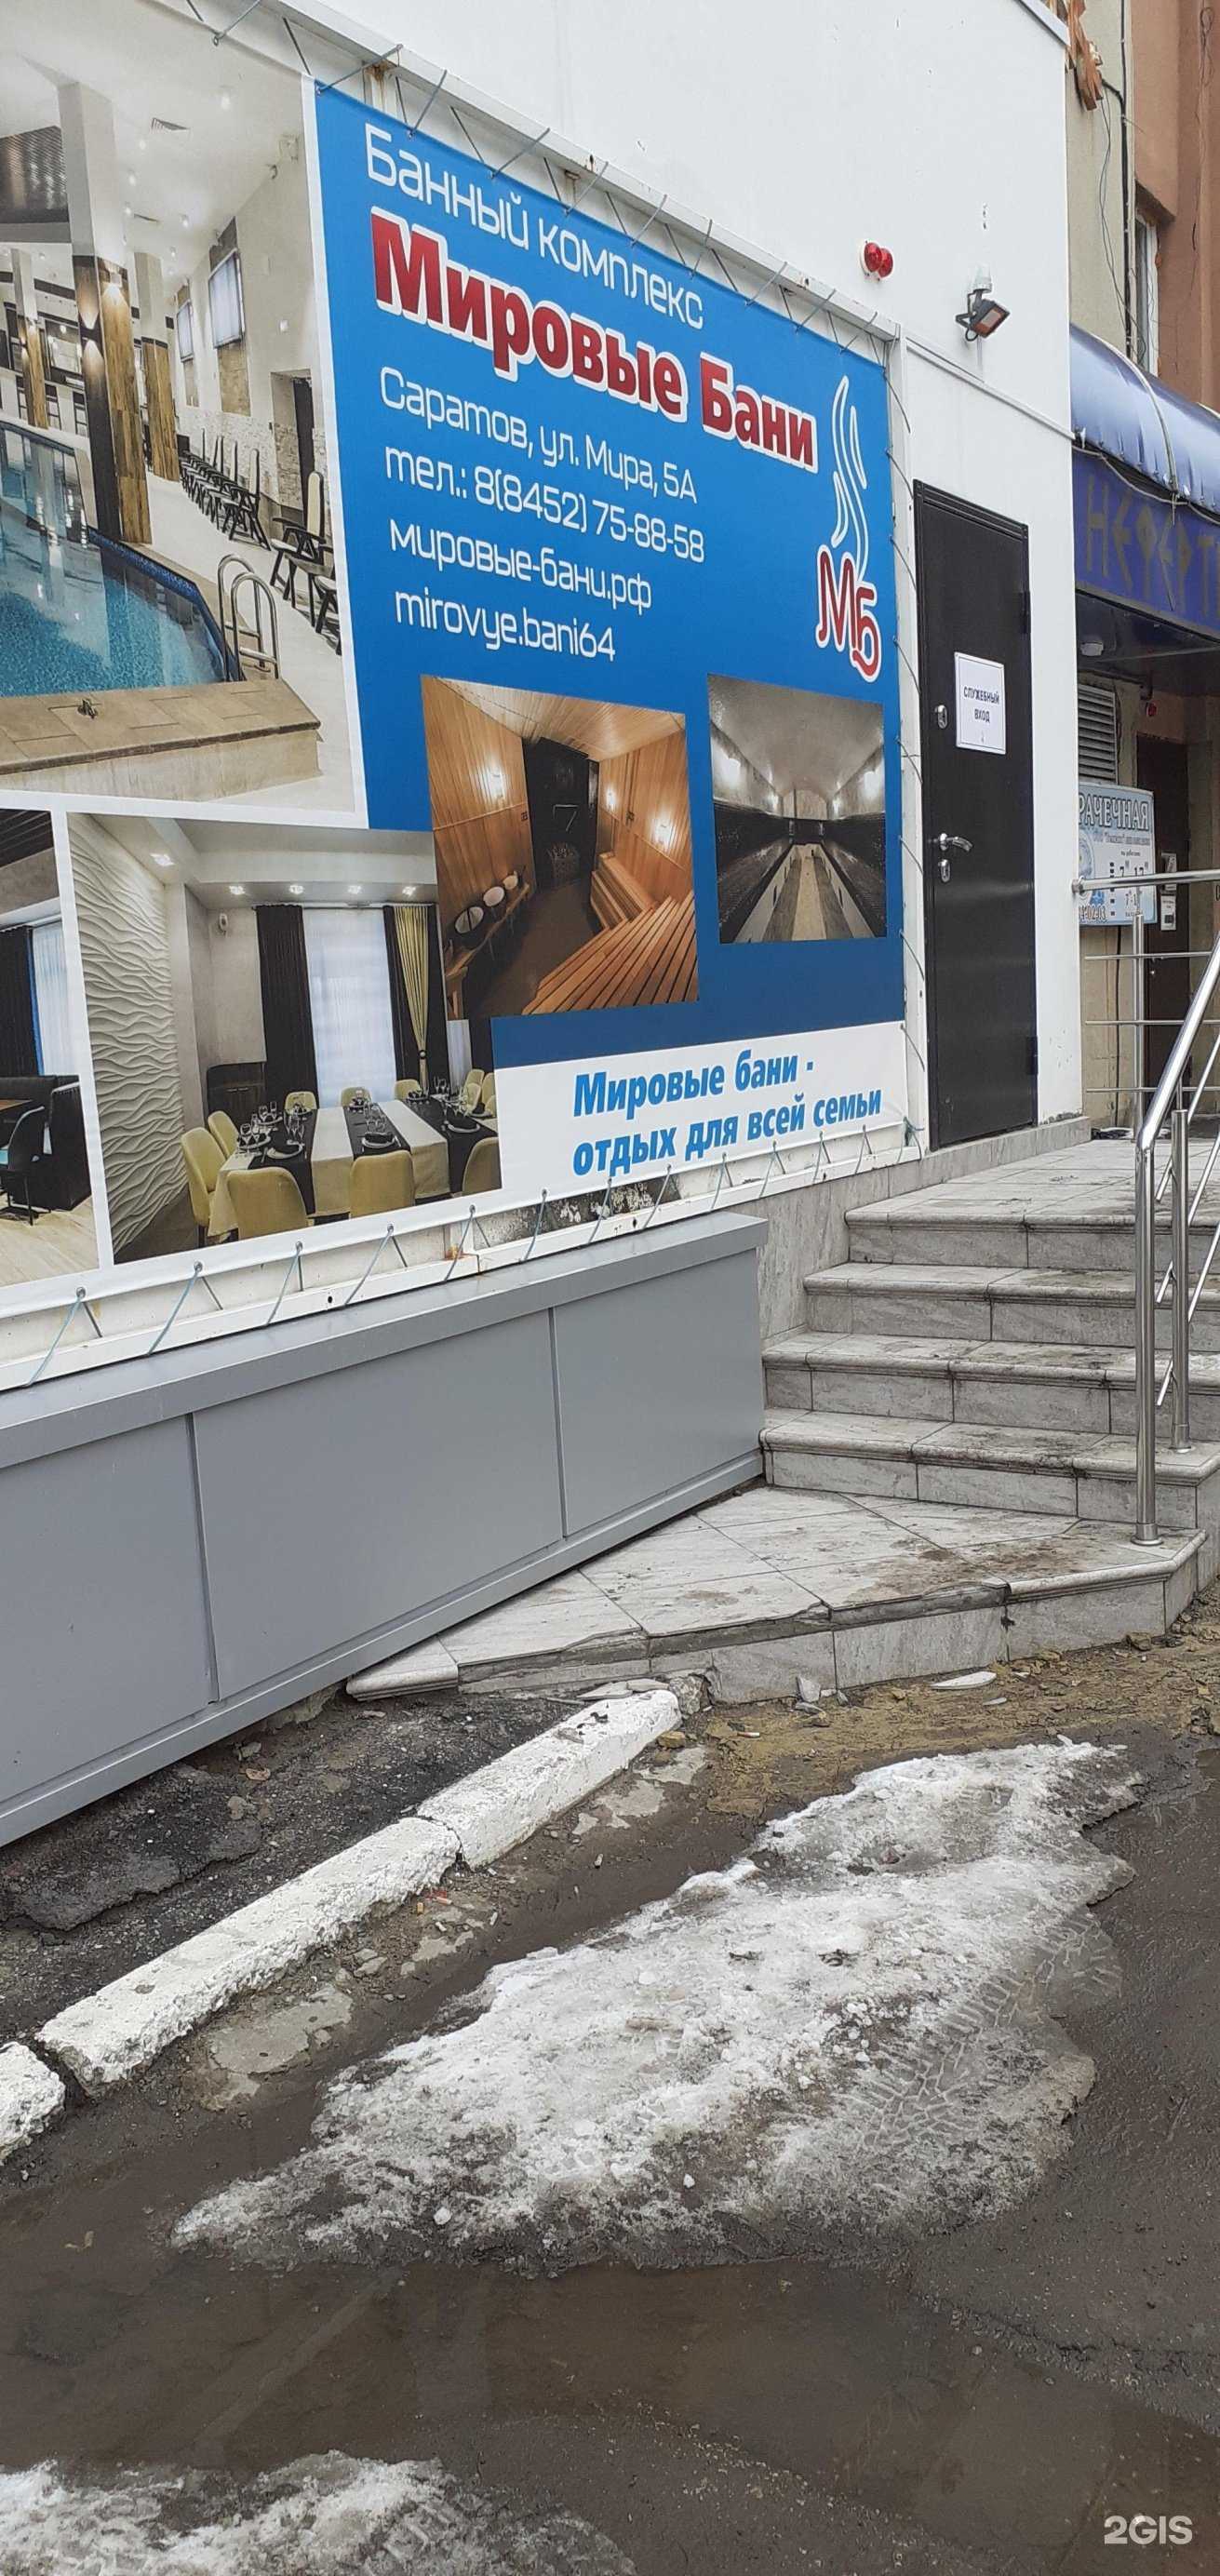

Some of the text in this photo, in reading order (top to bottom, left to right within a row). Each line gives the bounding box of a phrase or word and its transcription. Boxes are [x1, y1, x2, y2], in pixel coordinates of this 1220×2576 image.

[364, 123, 704, 329] Банный комплекс
[370, 207, 818, 474] Мировые Бани
[381, 367, 698, 503] Саратов, ул. Мира, 5А
[385, 446, 705, 563] тел.: 8(8452) 75-88-58
[390, 519, 651, 615] мировые-бани.рф
[395, 587, 616, 662] mirovye.bani64
[963, 686, 1000, 704] СЛУЖЕБНЫЙ
[974, 708, 990, 723] ВХОД
[1079, 792, 1149, 831] РАЧЕЧНАЯ
[572, 1064, 725, 1120] Мировые
[734, 1049, 799, 1092] бани
[571, 1088, 882, 1177] отдых для всей семьи
